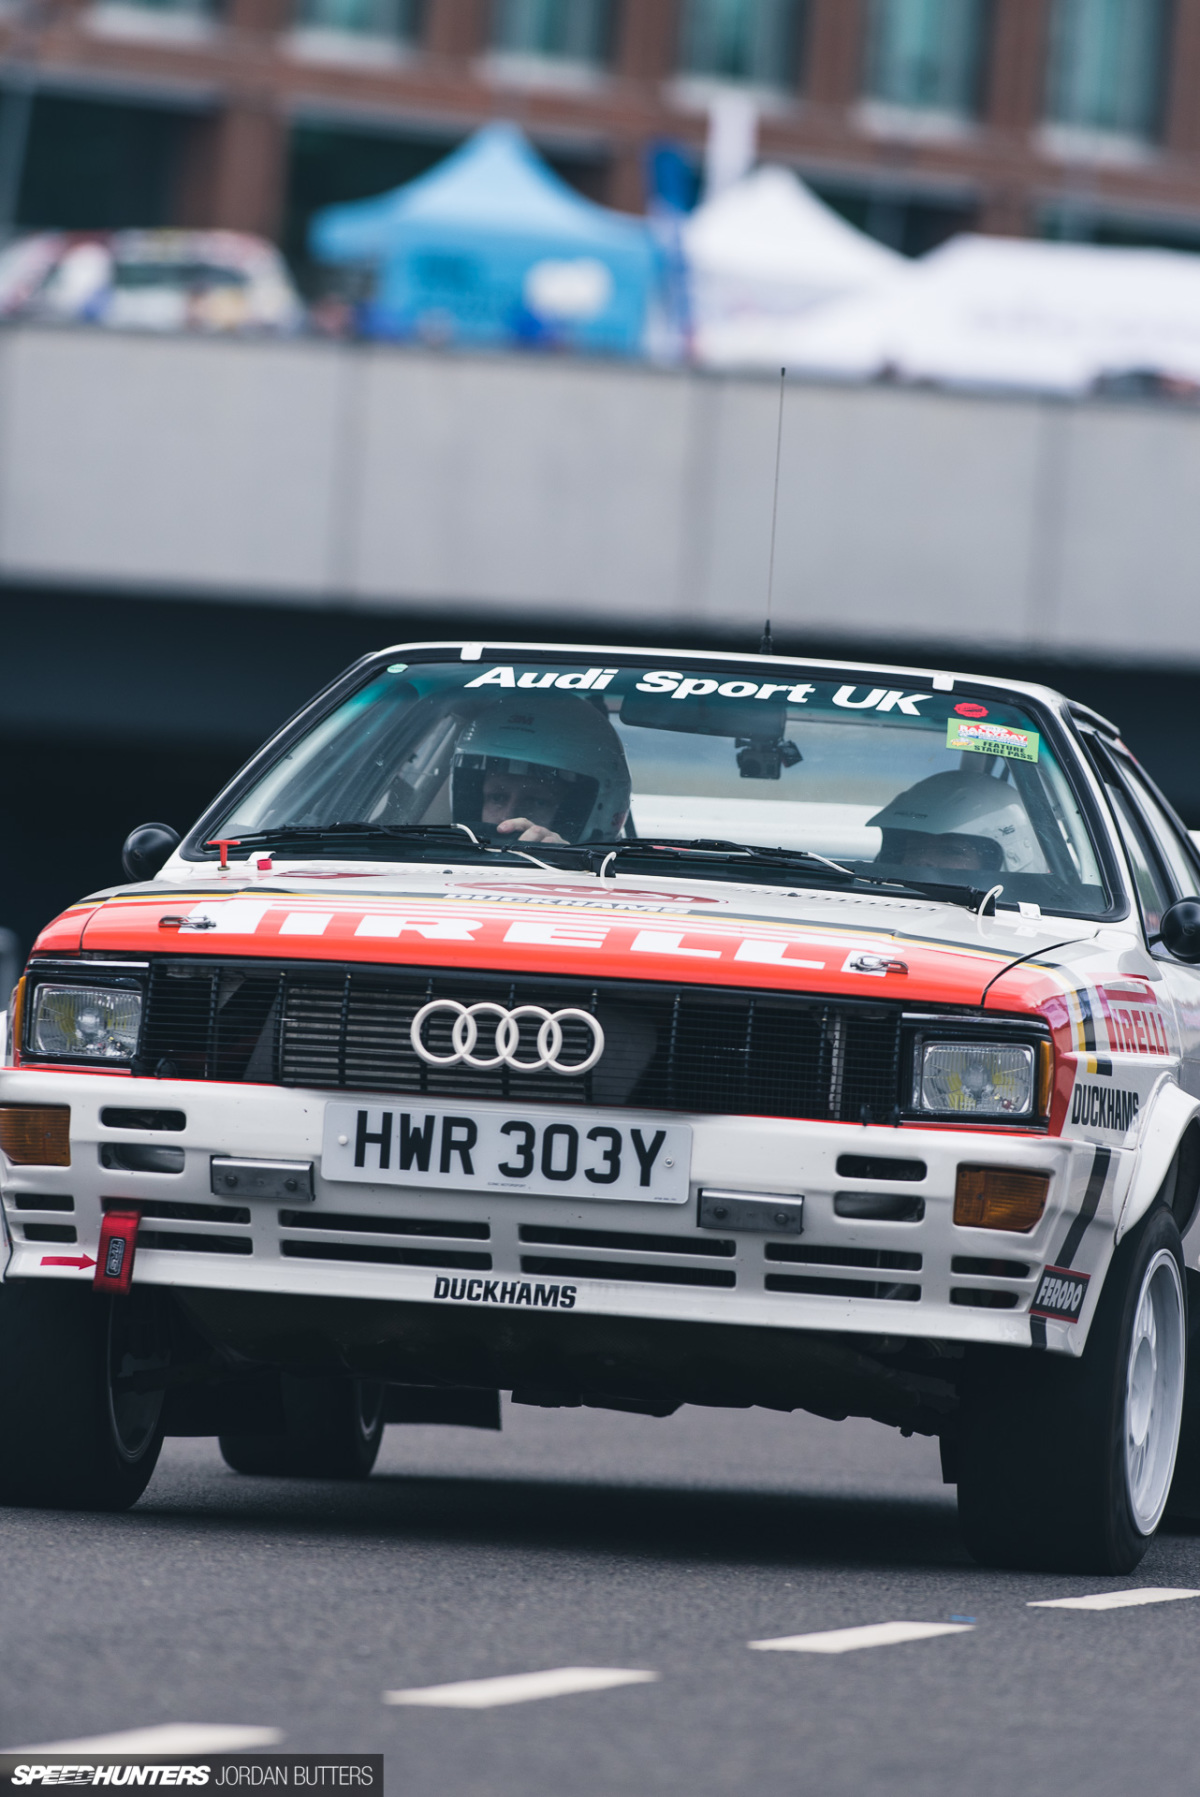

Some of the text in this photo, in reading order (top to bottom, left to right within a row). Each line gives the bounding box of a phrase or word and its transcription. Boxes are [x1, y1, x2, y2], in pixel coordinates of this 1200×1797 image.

[464, 667, 933, 716] Audi Sport UK
[974, 745, 1033, 761] STAGE PASS
[983, 741, 1025, 753] FEATURE
[443, 893, 692, 914] DUCKHAMS
[1084, 972, 1170, 1056] PIRELLI
[354, 1110, 667, 1187] HWR 303Y
[434, 1276, 577, 1309] DUCKHAMS
[1036, 1276, 1083, 1312] FERODO
